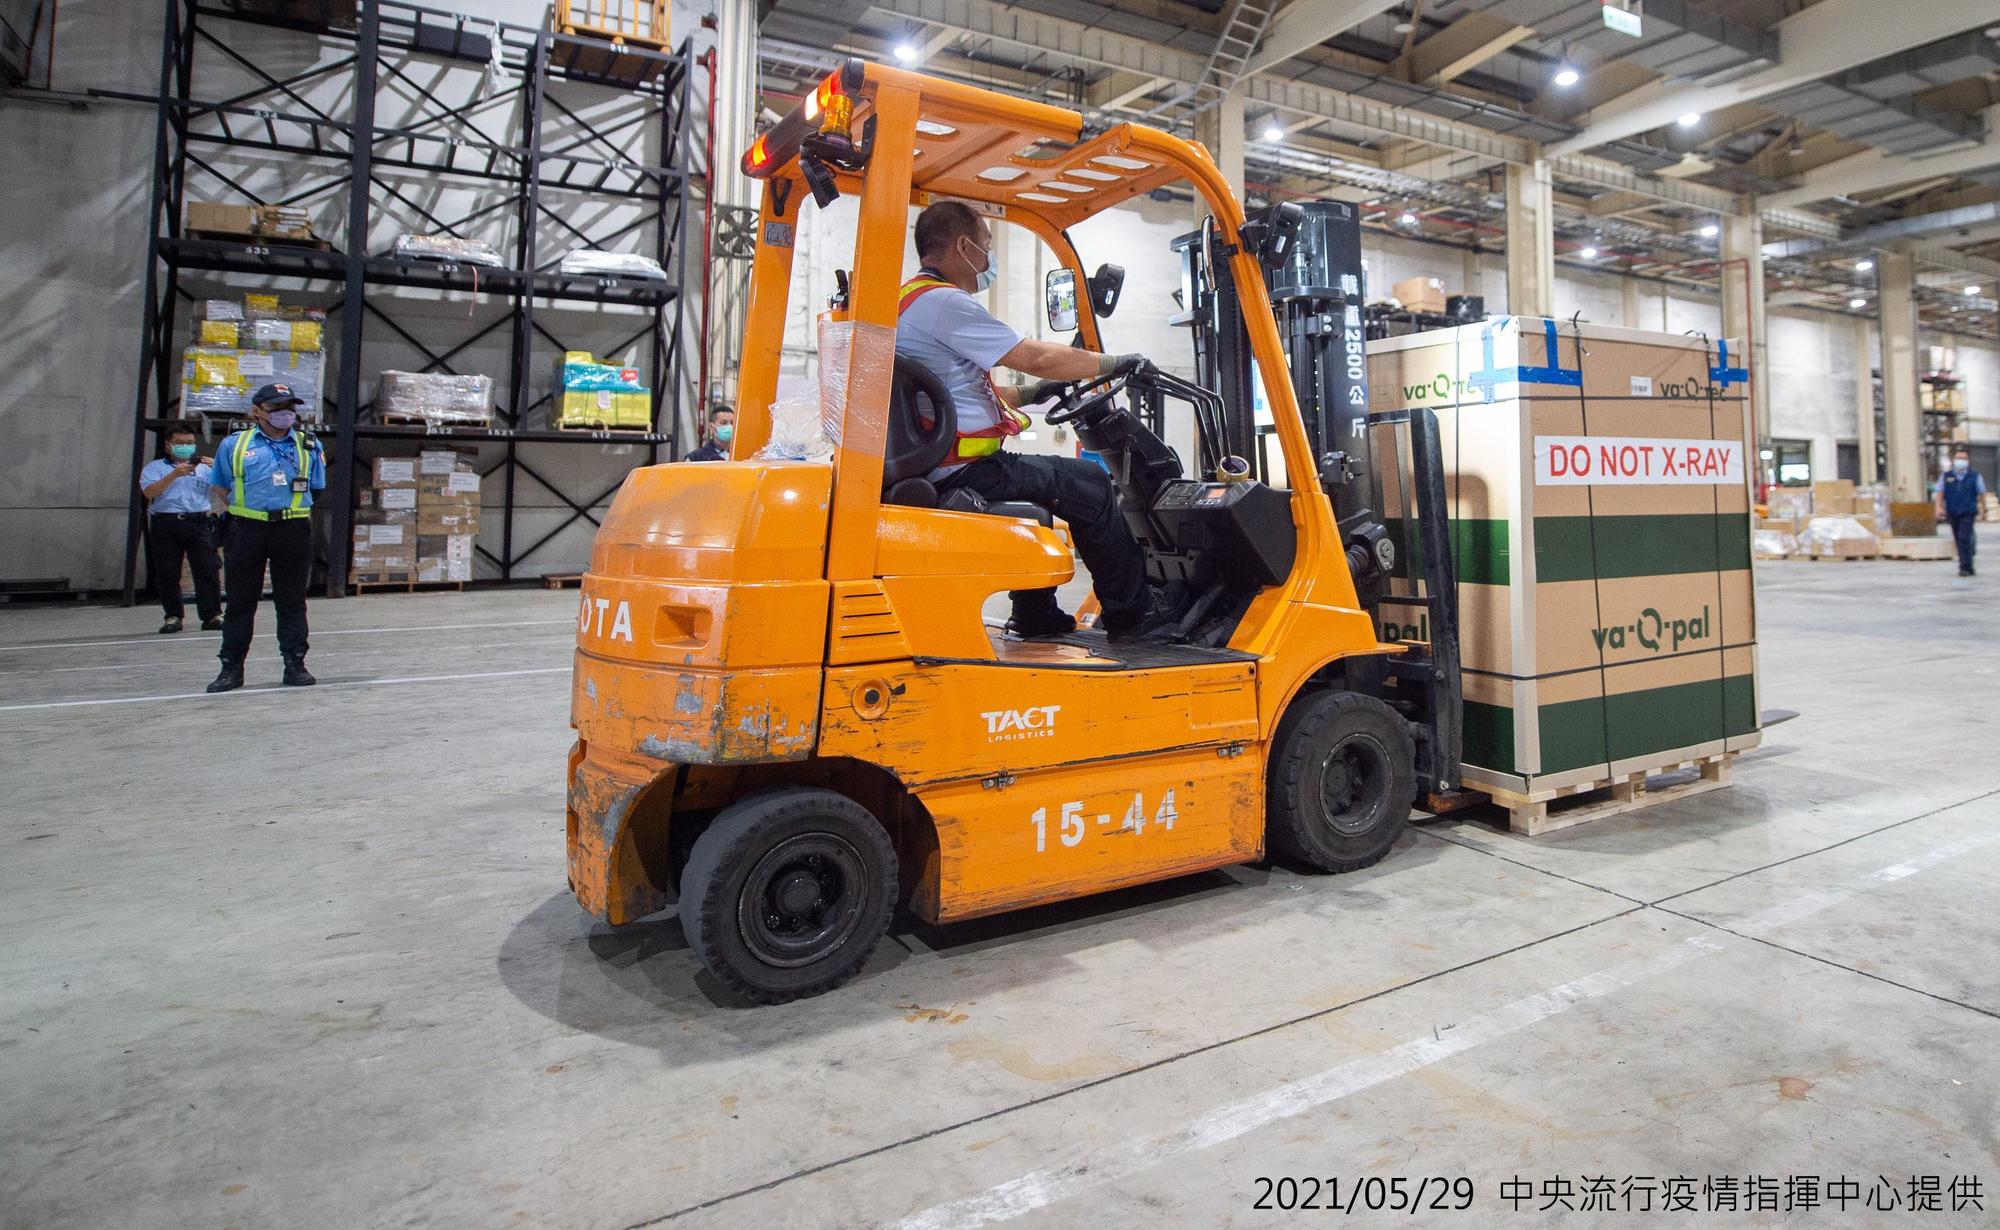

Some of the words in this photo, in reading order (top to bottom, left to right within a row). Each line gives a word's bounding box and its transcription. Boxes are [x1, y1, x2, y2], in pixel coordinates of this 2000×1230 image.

[245, 246, 269, 255] 533
[437, 264, 458, 273] 523
[598, 278, 617, 287] 513
[232, 422, 257, 430] 532
[1549, 444, 1591, 477] DO
[1600, 445, 1654, 477] NOT
[1662, 446, 1731, 477] X-RAY
[988, 729, 1054, 743] LOGISTICS
[1031, 789, 1180, 852] 15-44
